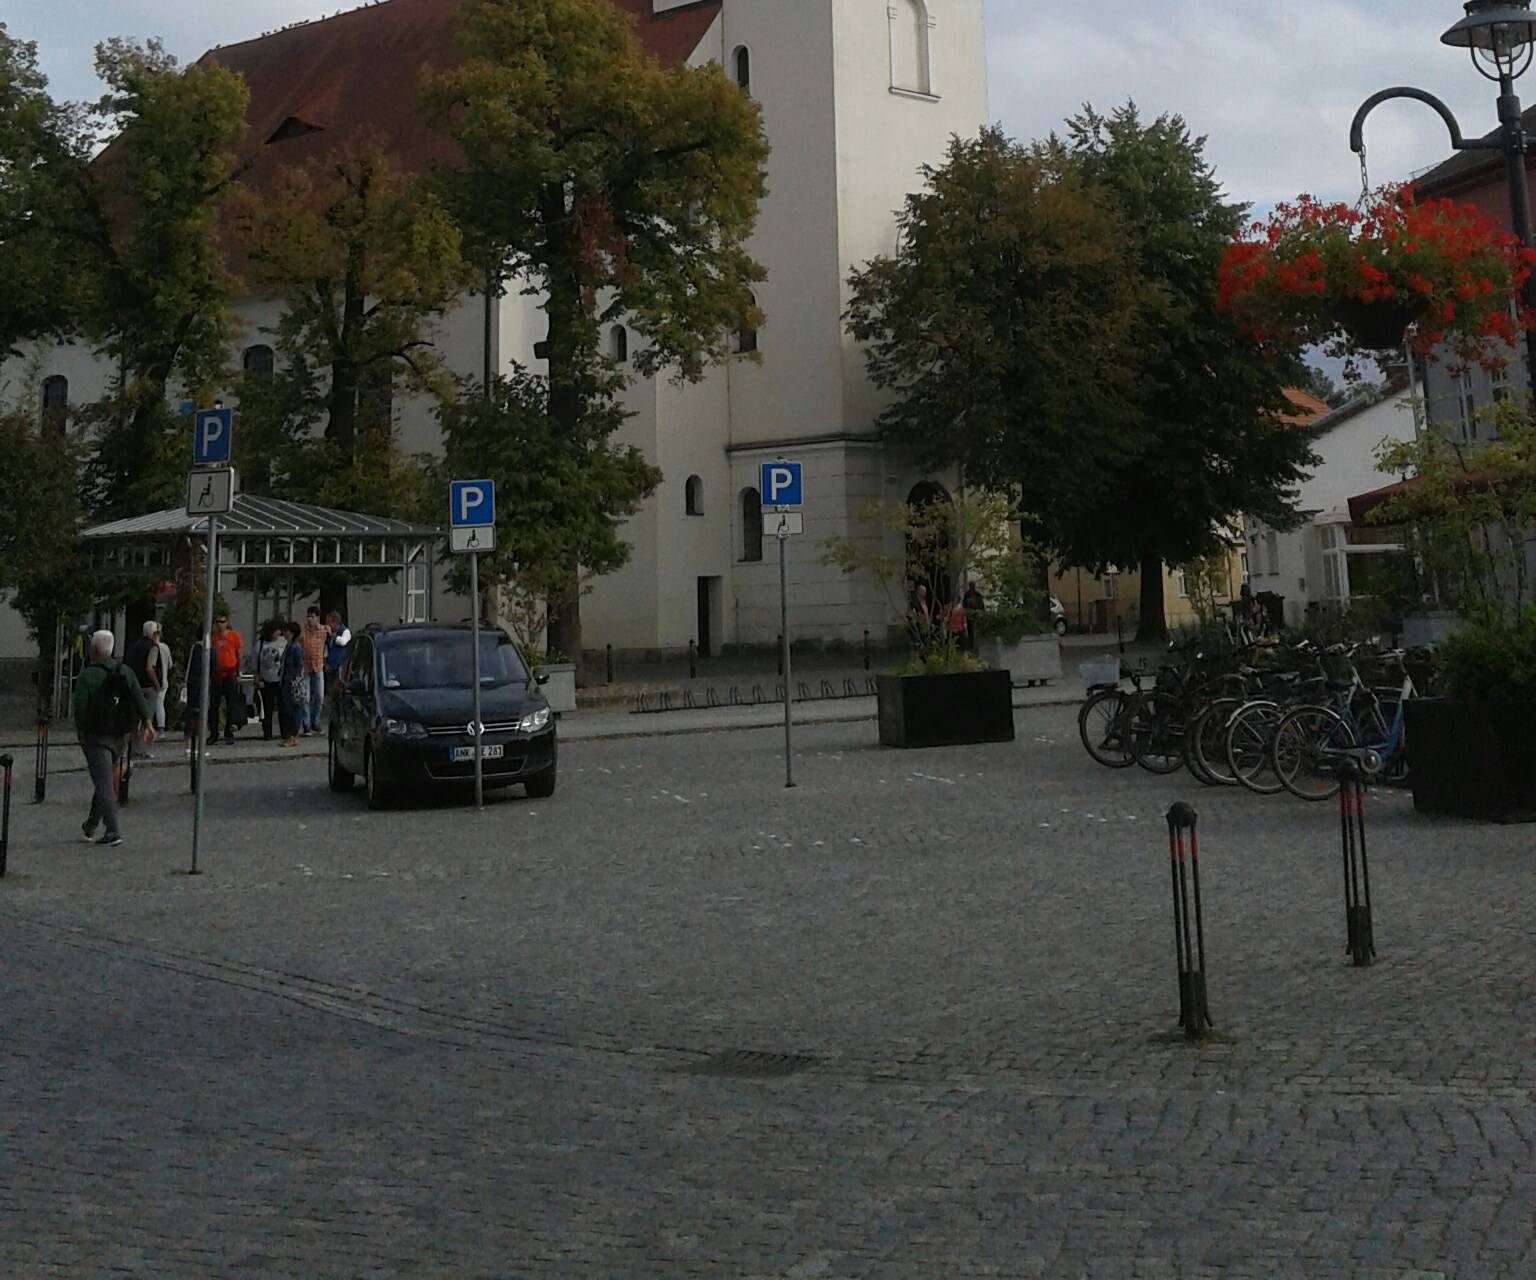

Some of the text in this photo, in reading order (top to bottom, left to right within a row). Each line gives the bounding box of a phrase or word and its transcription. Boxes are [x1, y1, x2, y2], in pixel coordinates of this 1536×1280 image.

[202, 416, 223, 457] P
[770, 468, 793, 501] P
[460, 486, 484, 520] P
